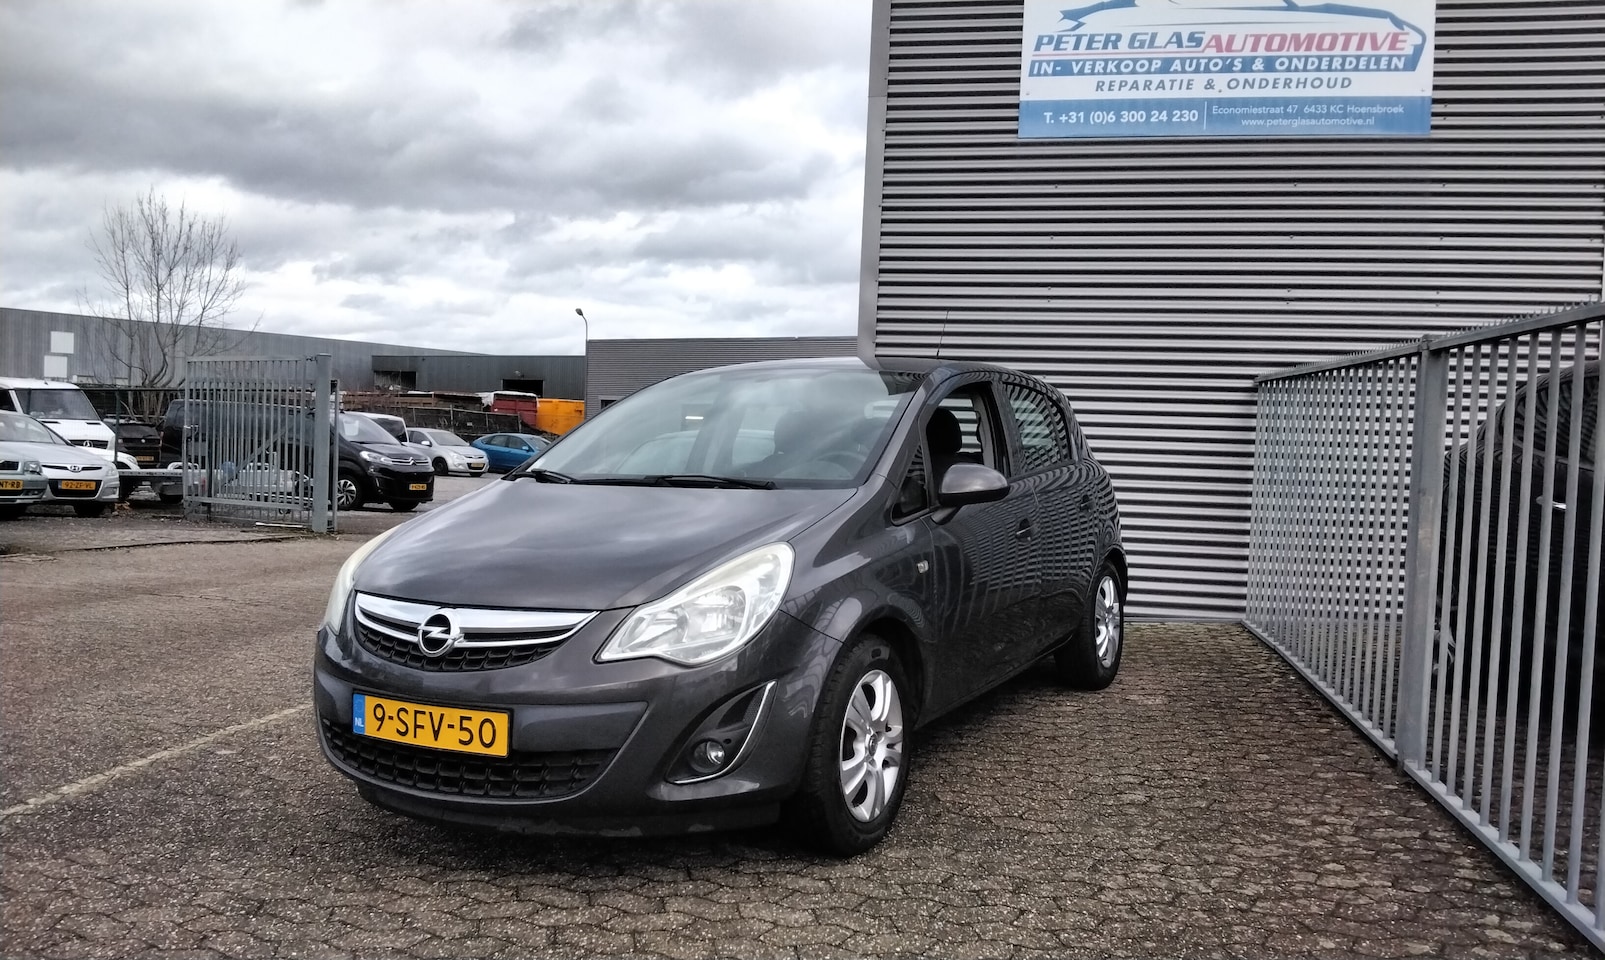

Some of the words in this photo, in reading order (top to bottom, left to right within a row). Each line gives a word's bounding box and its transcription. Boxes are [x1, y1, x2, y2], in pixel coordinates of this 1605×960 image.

[1034, 33, 1123, 51] PETER
[1033, 61, 1062, 74] IN-
[1071, 60, 1162, 74] VERKOOP
[1169, 57, 1243, 72] AUTO'S
[1252, 58, 1265, 71] &
[1275, 56, 1406, 71] ONDERDELEN
[1095, 78, 1195, 92] REPARATIE
[1203, 78, 1216, 90] &
[1227, 76, 1353, 90] ONDERHOUD
[1044, 112, 1054, 124] T.
[1059, 111, 1084, 123] +31
[1089, 110, 1116, 125] (0)6
[1120, 110, 1146, 122] 300
[1150, 110, 1168, 122] 24
[1172, 109, 1198, 122] 230
[1212, 105, 1284, 115] Economiestraat
[1286, 105, 1298, 114] 47
[1303, 105, 1328, 114] 6433
[1330, 105, 1344, 113] KC
[1347, 104, 1404, 114] Hoensbroek
[1241, 116, 1375, 128] www.peterglasautomotive.nl
[354, 717, 365, 728] NL
[373, 703, 497, 749] 9-SFV-50
